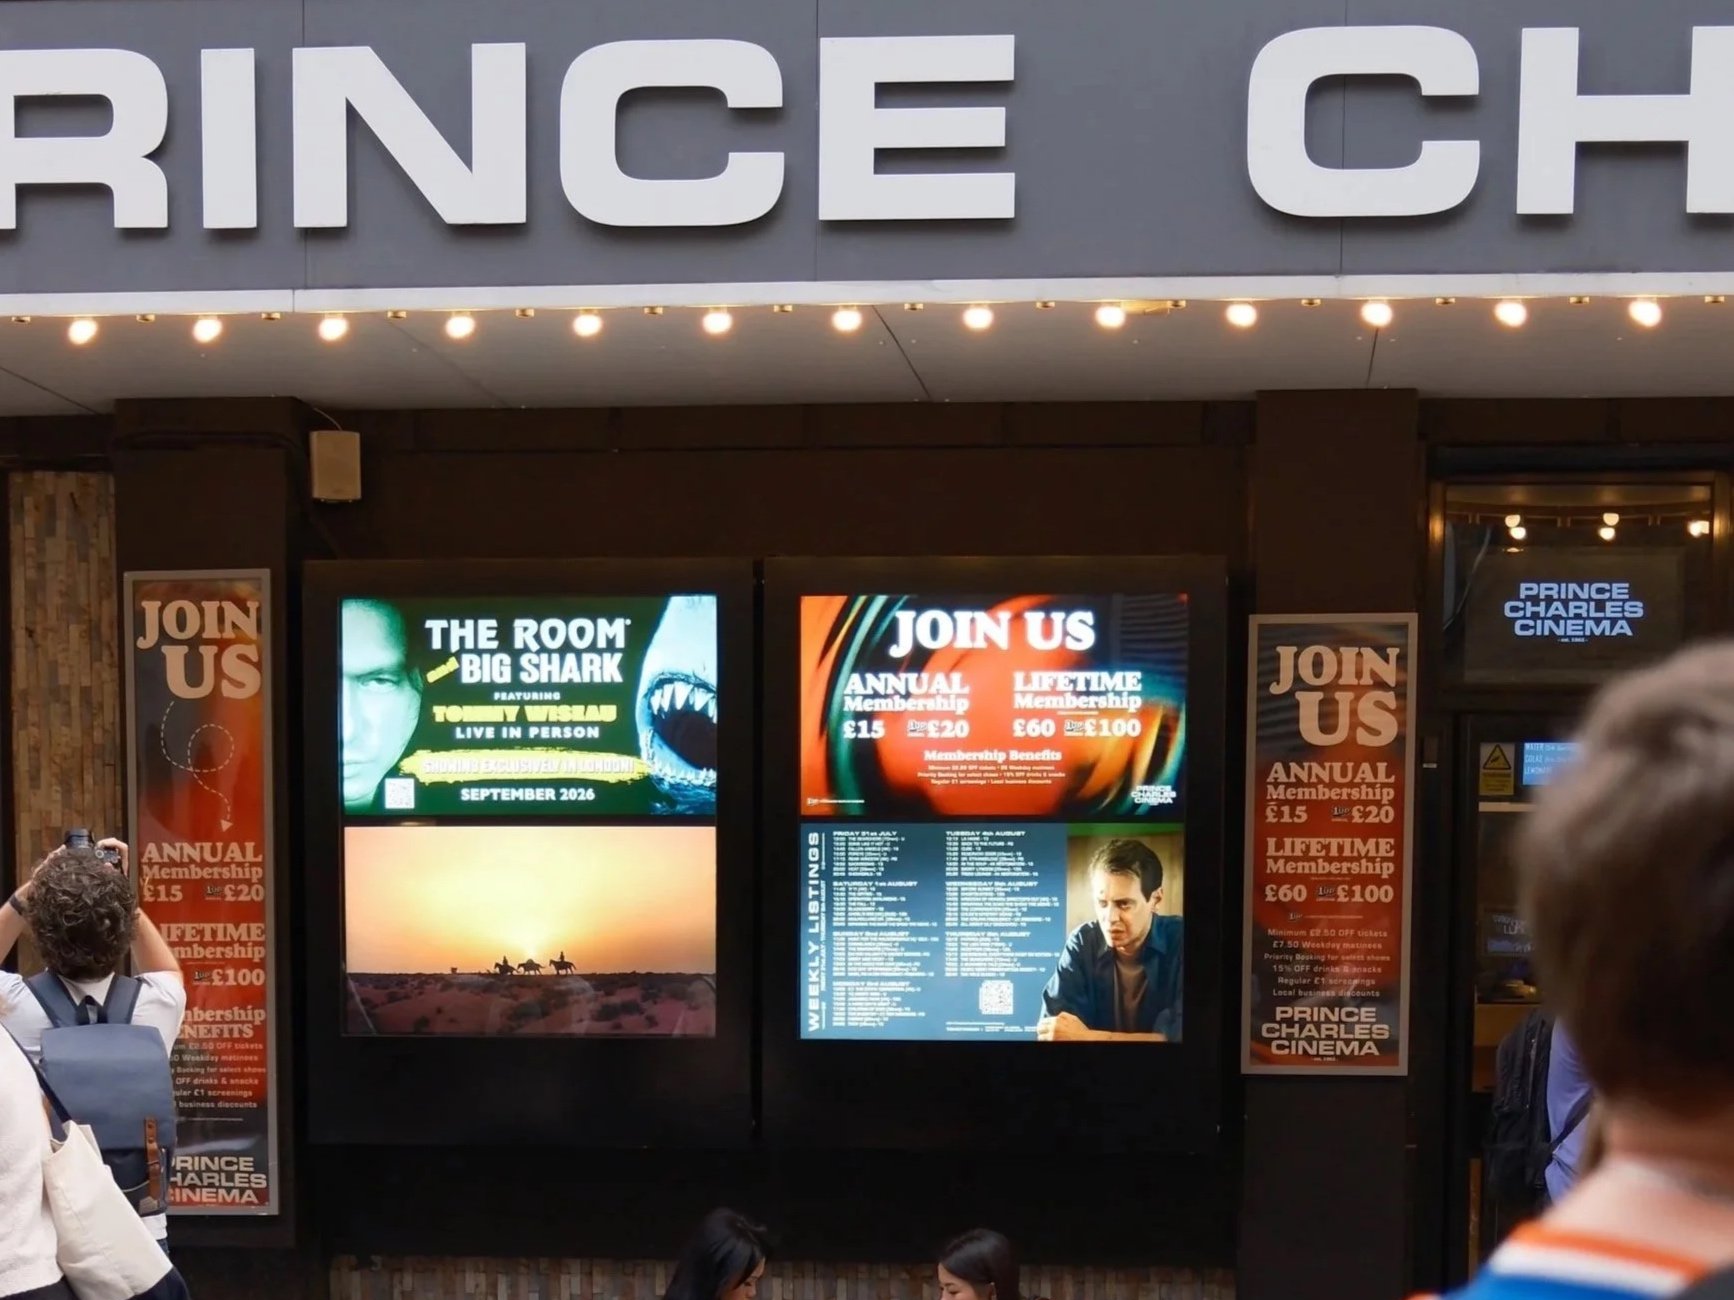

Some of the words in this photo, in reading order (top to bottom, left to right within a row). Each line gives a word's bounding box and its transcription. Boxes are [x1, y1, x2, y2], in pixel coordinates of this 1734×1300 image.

[0, 35, 1016, 230] RINCE
[1247, 26, 1734, 217] CH
[1519, 582, 1630, 600] PRINCE
[1504, 601, 1644, 618] CHARLES
[136, 600, 260, 650] JOIN
[889, 609, 1011, 658] JOIN
[1024, 610, 1096, 651] US
[1514, 619, 1634, 636] CINEMA
[425, 619, 499, 653] THE
[514, 618, 625, 654] ROOM
[161, 644, 262, 700] US
[461, 653, 512, 684] BIG
[520, 652, 624, 684] SHARK
[1270, 644, 1400, 694] JOIN
[844, 672, 970, 695] ANNUAL
[1014, 670, 1142, 692] LIFETIME
[494, 691, 561, 700] FEATURING
[844, 694, 970, 715] Membership
[1014, 692, 1142, 713] Membership
[433, 704, 520, 722] TOMMY
[1295, 690, 1400, 746] US
[456, 726, 496, 739] LIVE
[502, 726, 522, 738] IN
[529, 726, 600, 738] PERSON
[844, 719, 886, 738] £15
[926, 719, 970, 738] £20
[1013, 718, 1056, 738] £60
[1086, 718, 1142, 738] £100
[924, 748, 1006, 764] Membership
[1008, 748, 1062, 760] Benefits
[1266, 762, 1395, 783] ANNUAL
[460, 788, 556, 802] SEPTEMBER
[560, 788, 596, 801] 2026
[1266, 784, 1394, 804] Membership
[1265, 805, 1308, 823] £15
[1352, 805, 1394, 824] £20
[142, 842, 263, 862] ANNUAL
[1266, 837, 1395, 857] LIFETIME
[142, 863, 264, 882] Membership
[1266, 858, 1394, 879] Membership
[808, 832, 820, 933] LISTINGS
[144, 885, 183, 902] £15
[224, 884, 264, 902] £20
[1265, 884, 1307, 902] £60
[1336, 884, 1394, 902] £100
[160, 922, 266, 942] IFETIME
[172, 943, 266, 962] mbership
[1302, 941, 1340, 950] Weekday
[1264, 953, 1293, 962] Priority
[1295, 953, 1326, 962] Booking
[212, 968, 266, 986] £100
[808, 941, 820, 1032] WEEKLY
[1278, 977, 1311, 986] Regular
[1327, 978, 1376, 986] screenings
[1275, 1006, 1376, 1022] PRINCE
[1261, 1022, 1390, 1040] CHARLES
[216, 1042, 232, 1050] OFF
[234, 1042, 263, 1050] tickets
[1270, 1040, 1380, 1056] CINEMA
[182, 1054, 218, 1062] Weekday
[208, 1089, 252, 1098] screenings
[171, 1156, 254, 1172] RINCE
[170, 1172, 267, 1188] HARLES
